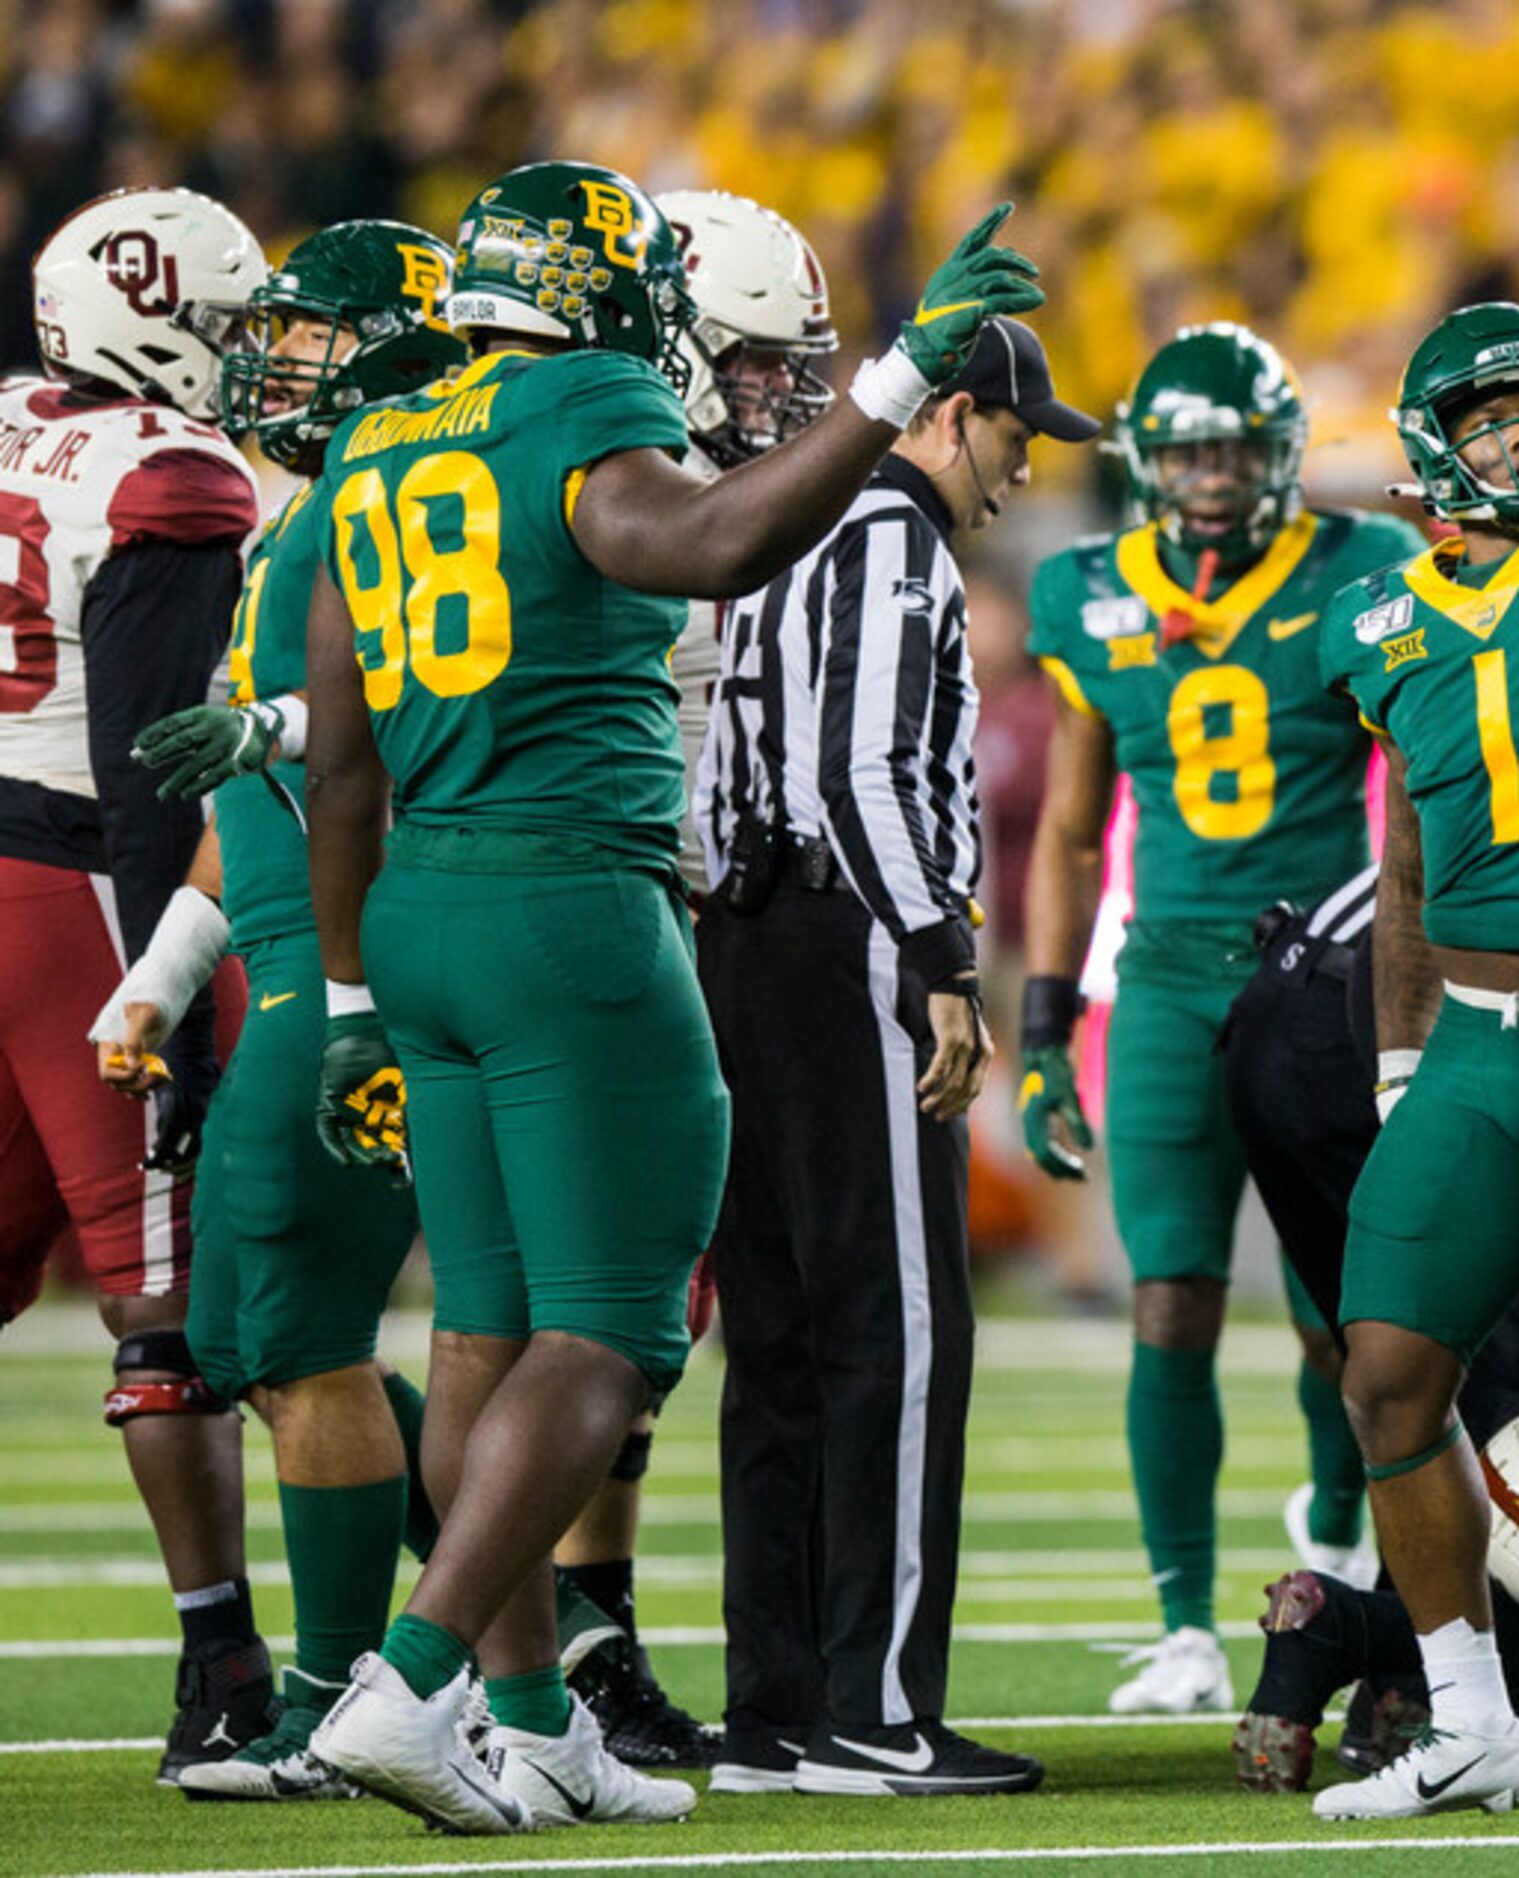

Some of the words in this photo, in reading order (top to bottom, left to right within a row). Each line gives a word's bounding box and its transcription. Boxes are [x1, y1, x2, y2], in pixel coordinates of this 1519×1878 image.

[579, 180, 649, 269] BU
[106, 230, 180, 318] OU
[32, 429, 92, 483] JR.
[331, 449, 513, 713] 98
[1167, 664, 1276, 840] 8
